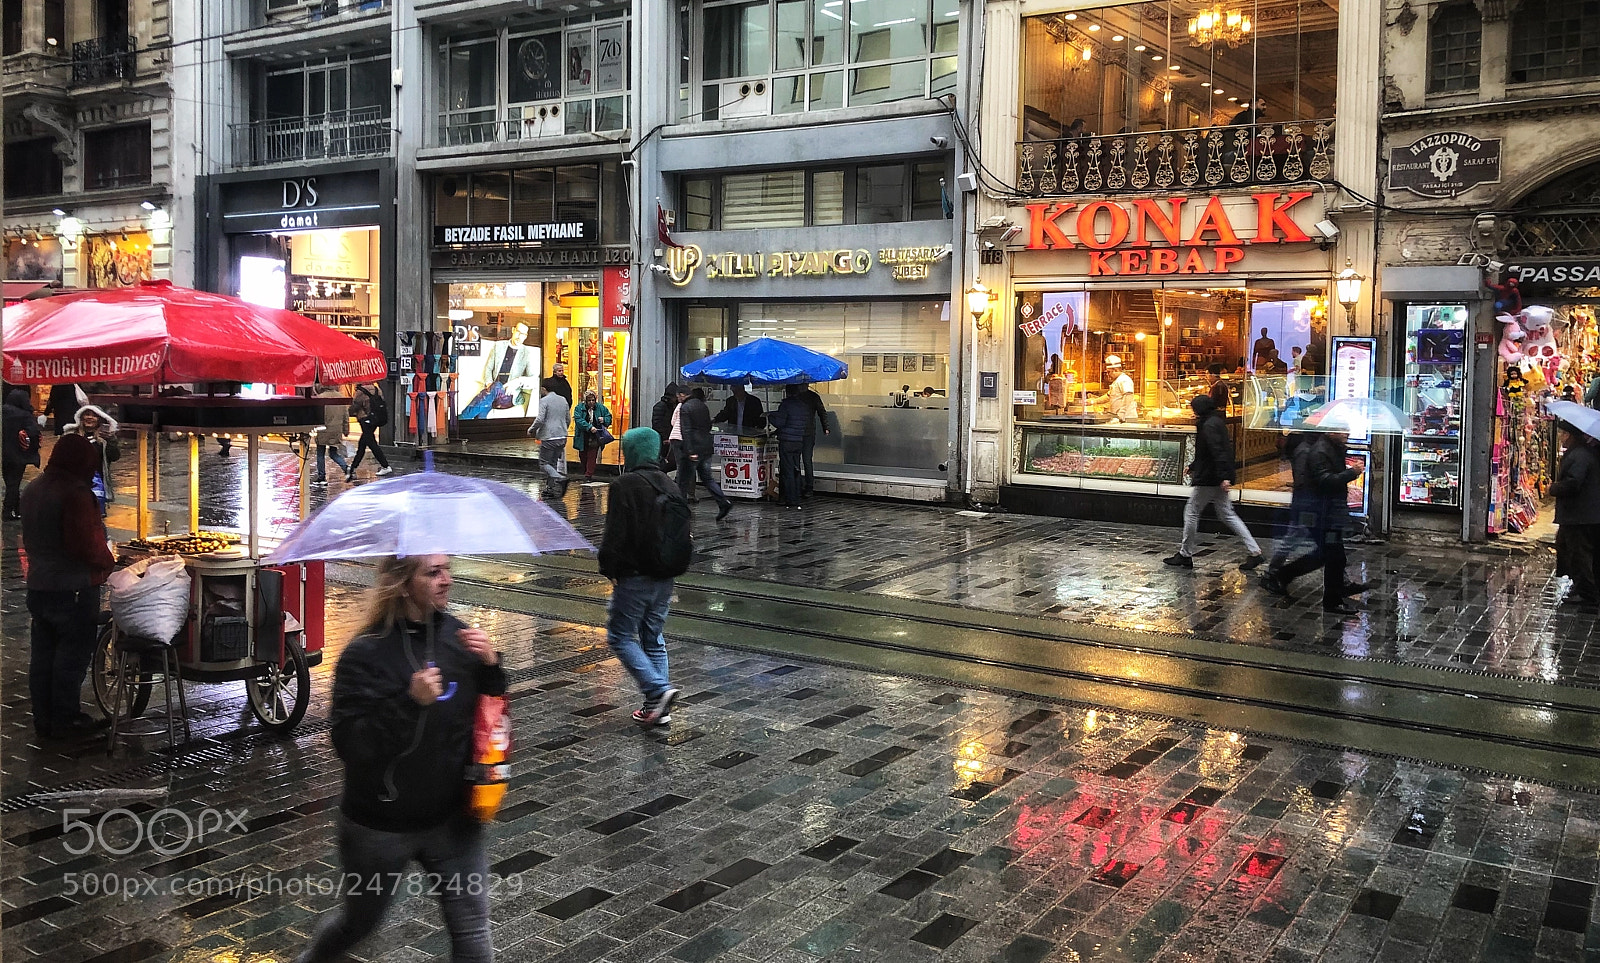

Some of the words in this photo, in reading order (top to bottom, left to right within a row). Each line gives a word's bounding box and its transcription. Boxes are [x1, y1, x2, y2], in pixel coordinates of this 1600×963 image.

[1409, 134, 1481, 156] HAZZOPULO
[281, 177, 318, 208] D'S
[281, 212, 318, 228] damat
[1025, 192, 1313, 250] KONAK
[444, 226, 491, 243] BEYZADE
[494, 225, 525, 241] FASIL
[527, 222, 584, 240] MEYHANE
[451, 251, 554, 265] GALTASARAY
[560, 250, 599, 263] HANI
[983, 250, 1002, 264] 118
[1088, 248, 1245, 276] KEBAP
[1019, 302, 1065, 338] TERRACE
[26, 356, 87, 379] BEYOĞLU
[401, 359, 411, 368] 15
[725, 463, 751, 479] 61
